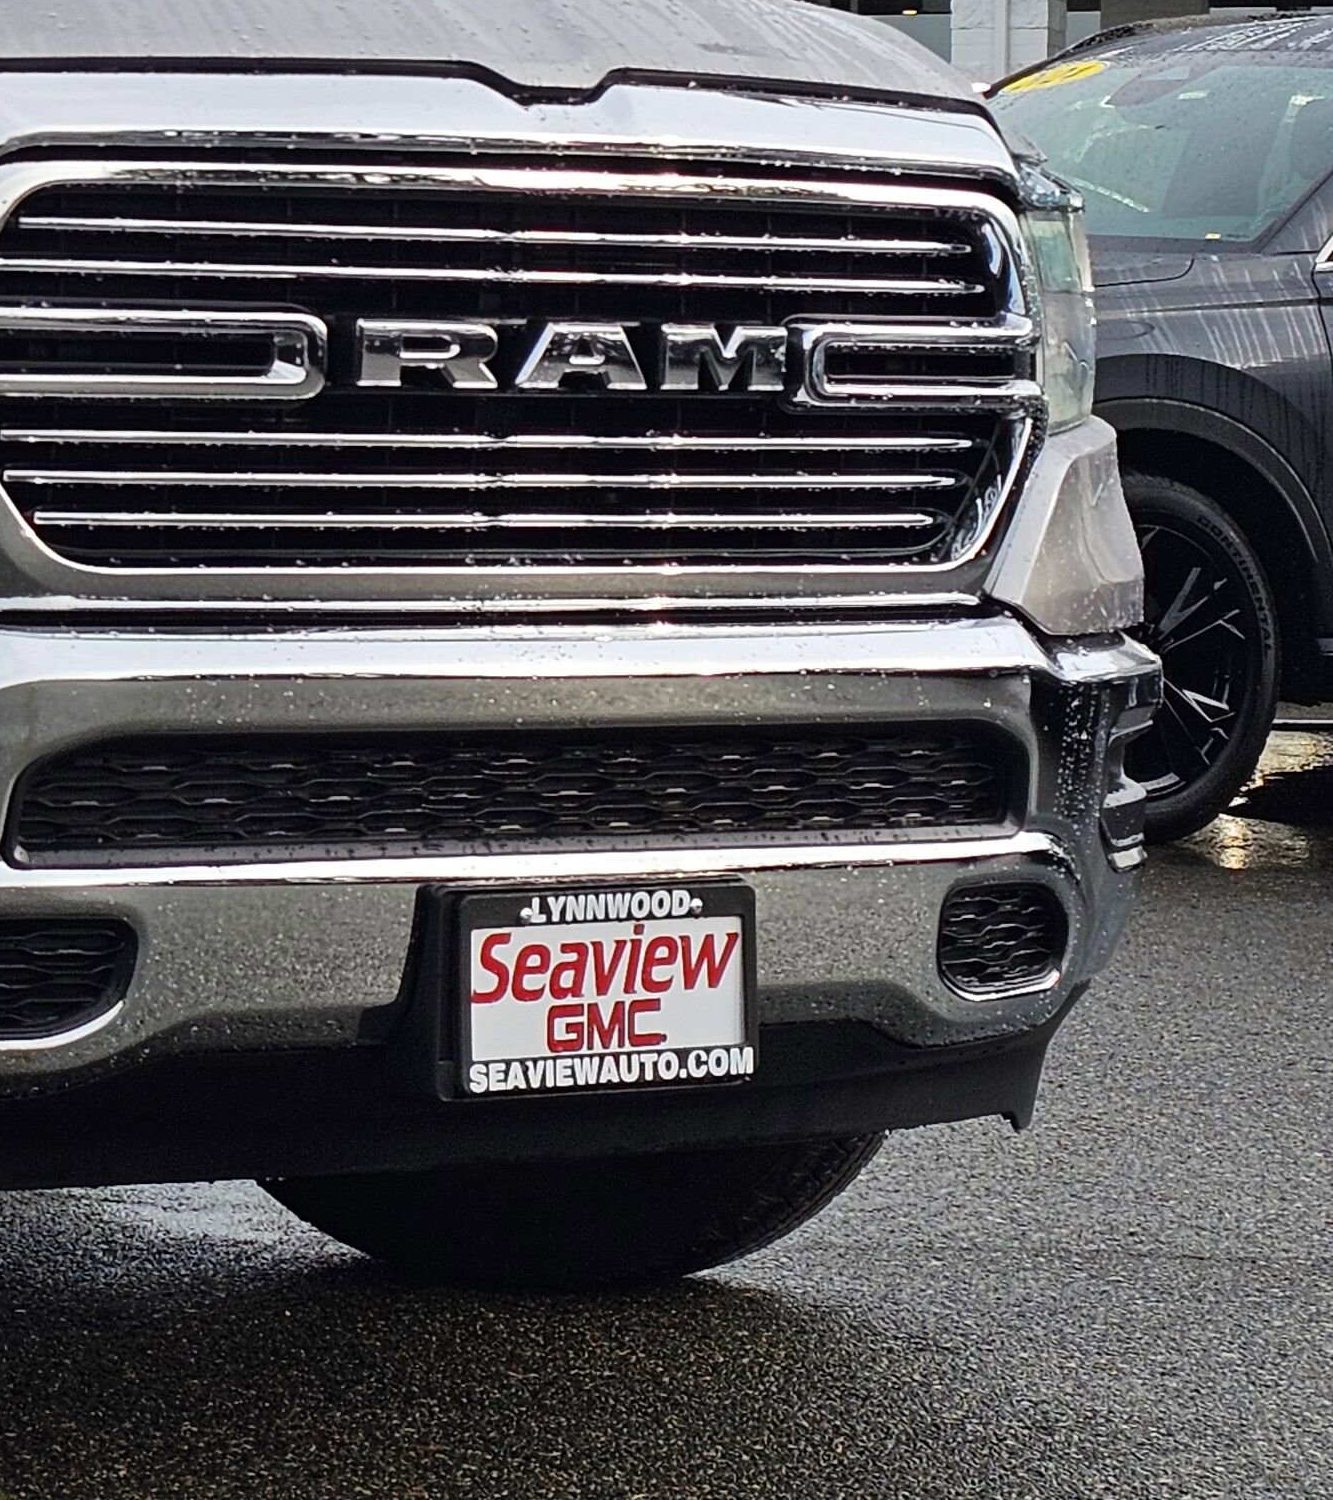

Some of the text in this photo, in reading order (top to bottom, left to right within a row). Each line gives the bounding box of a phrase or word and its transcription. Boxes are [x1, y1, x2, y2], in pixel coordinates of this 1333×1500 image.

[356, 318, 789, 391] RAM
[531, 889, 692, 924] LYNNWOOD
[471, 923, 740, 1004] Seaview
[546, 998, 664, 1053] GMC
[469, 1047, 754, 1093] SEAVIEWAUTO.COM
